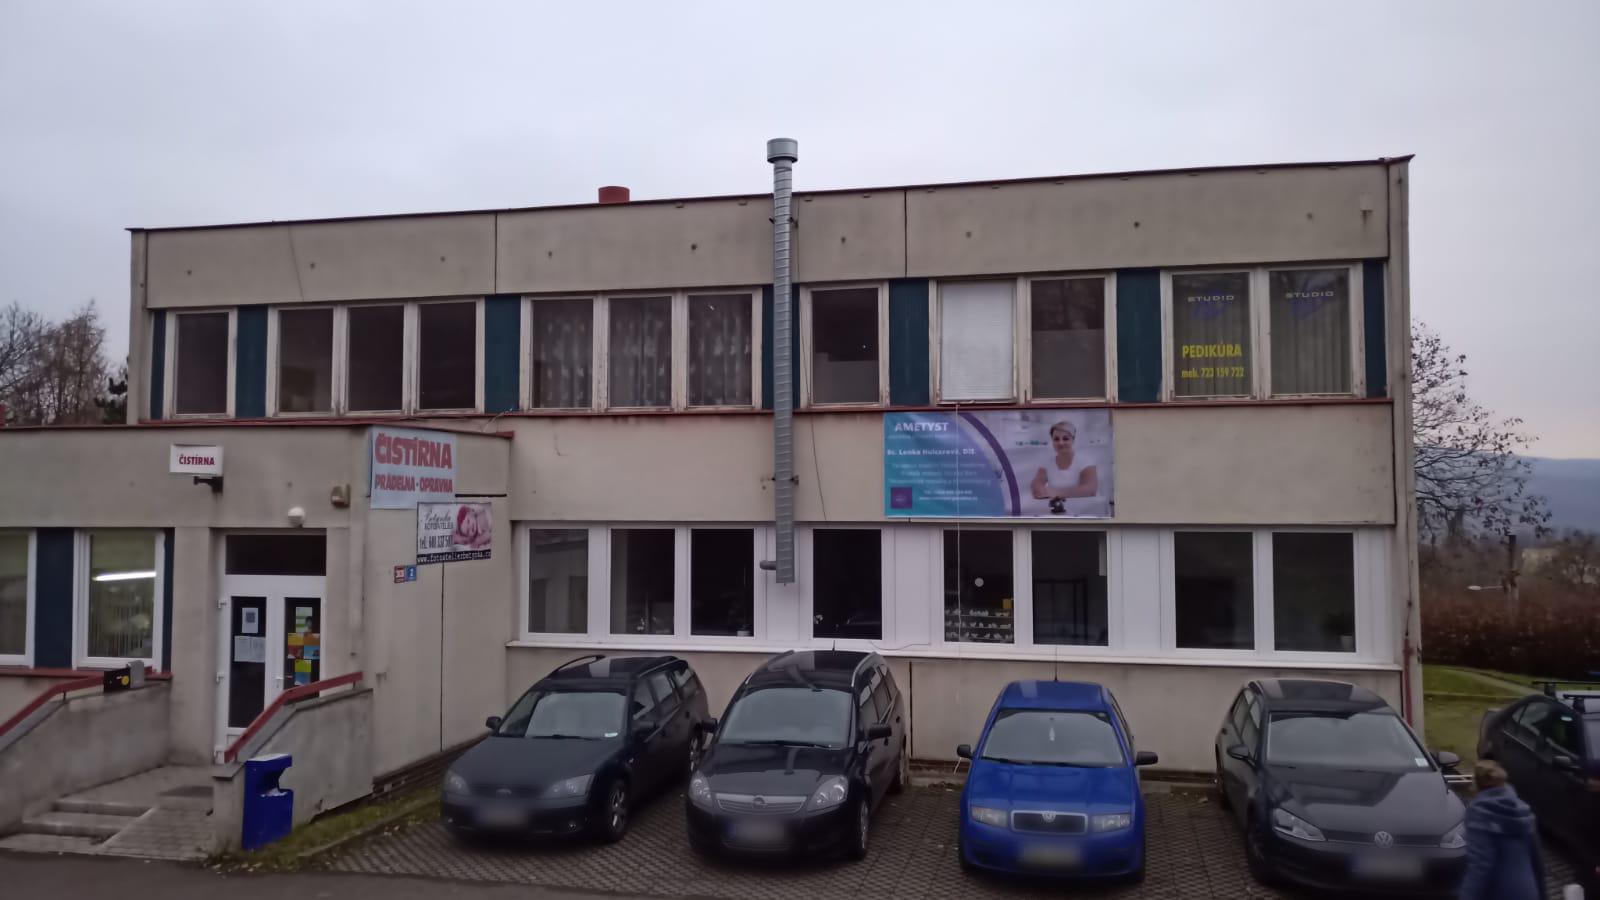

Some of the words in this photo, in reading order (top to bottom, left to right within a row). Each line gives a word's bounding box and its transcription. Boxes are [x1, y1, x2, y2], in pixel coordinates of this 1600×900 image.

[895, 422, 949, 432] AMETYST
[375, 433, 452, 469] ČISTÍRNA
[899, 447, 921, 456] Lenka
[179, 453, 215, 465] ČISTÍRNA
